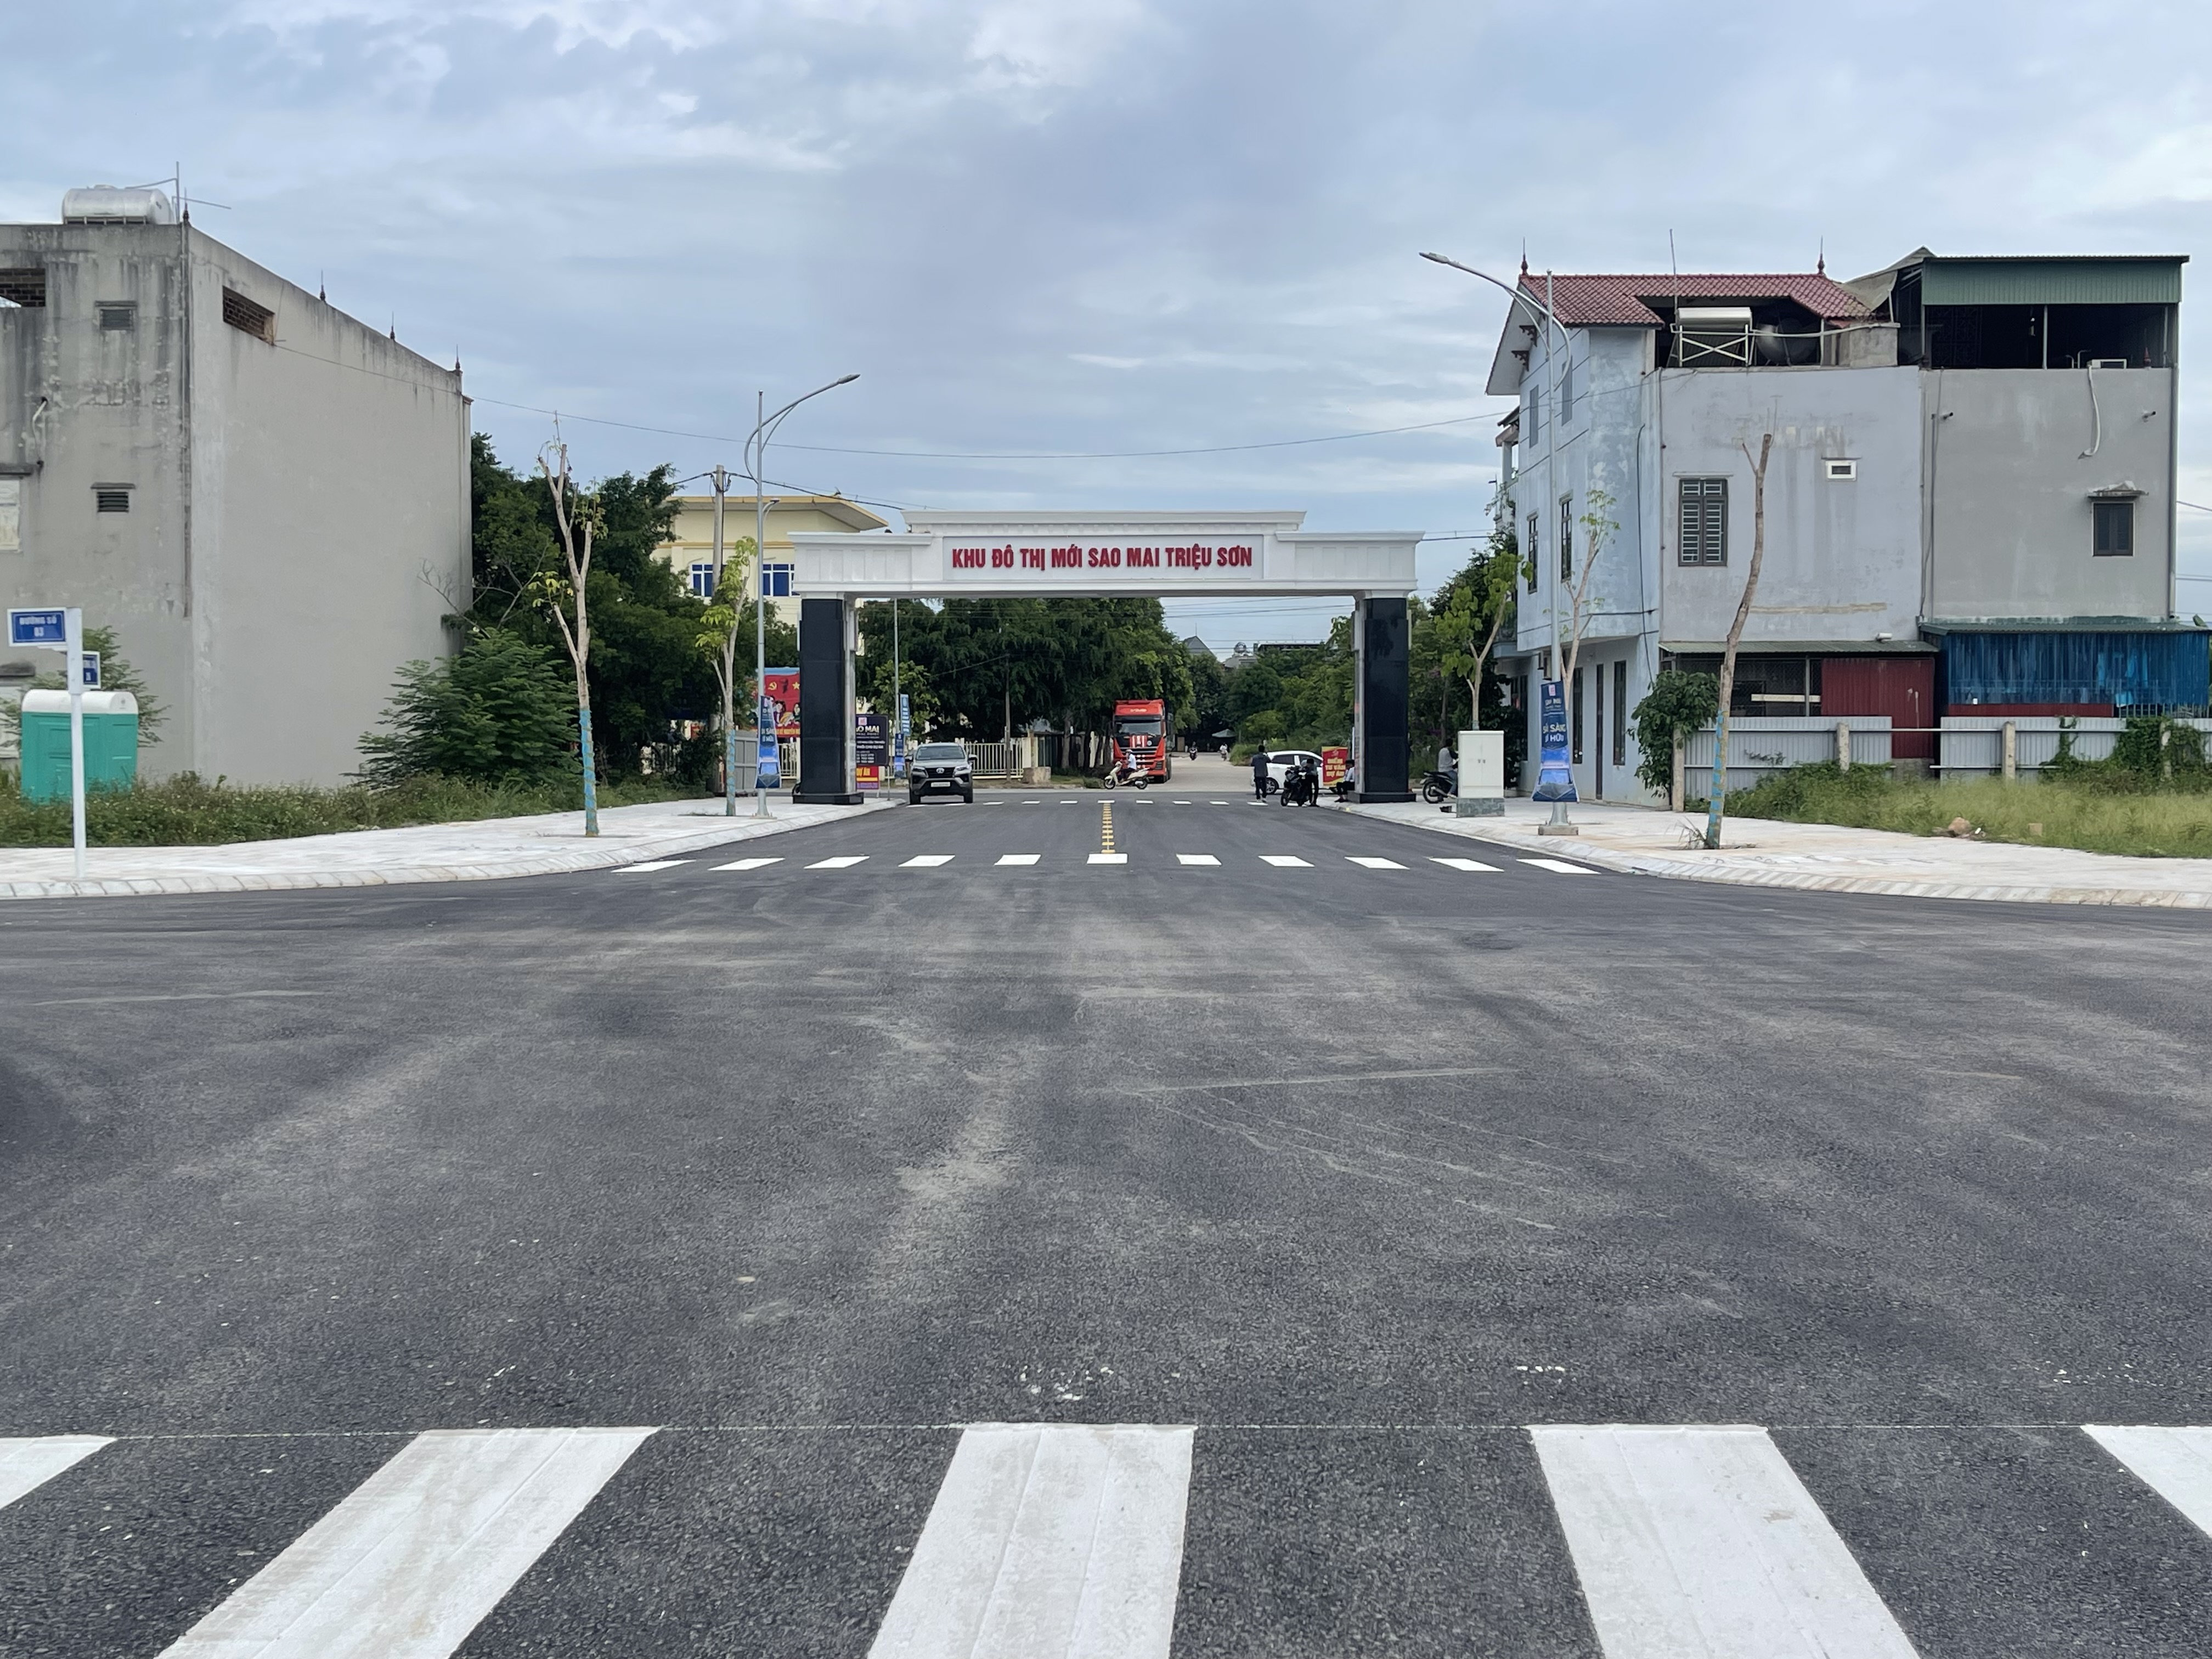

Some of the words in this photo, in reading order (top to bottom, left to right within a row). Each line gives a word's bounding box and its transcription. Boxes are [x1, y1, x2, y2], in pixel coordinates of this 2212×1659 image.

[952, 548, 985, 568] KHU
[991, 544, 1014, 568] ĐÔ
[1020, 548, 1046, 570] THỊ
[1051, 544, 1082, 567] MỚI
[1088, 548, 1120, 567] SAO
[1126, 547, 1160, 567] MAI
[1165, 544, 1211, 569] TRIỆU
[1217, 545, 1252, 566] SƠN
